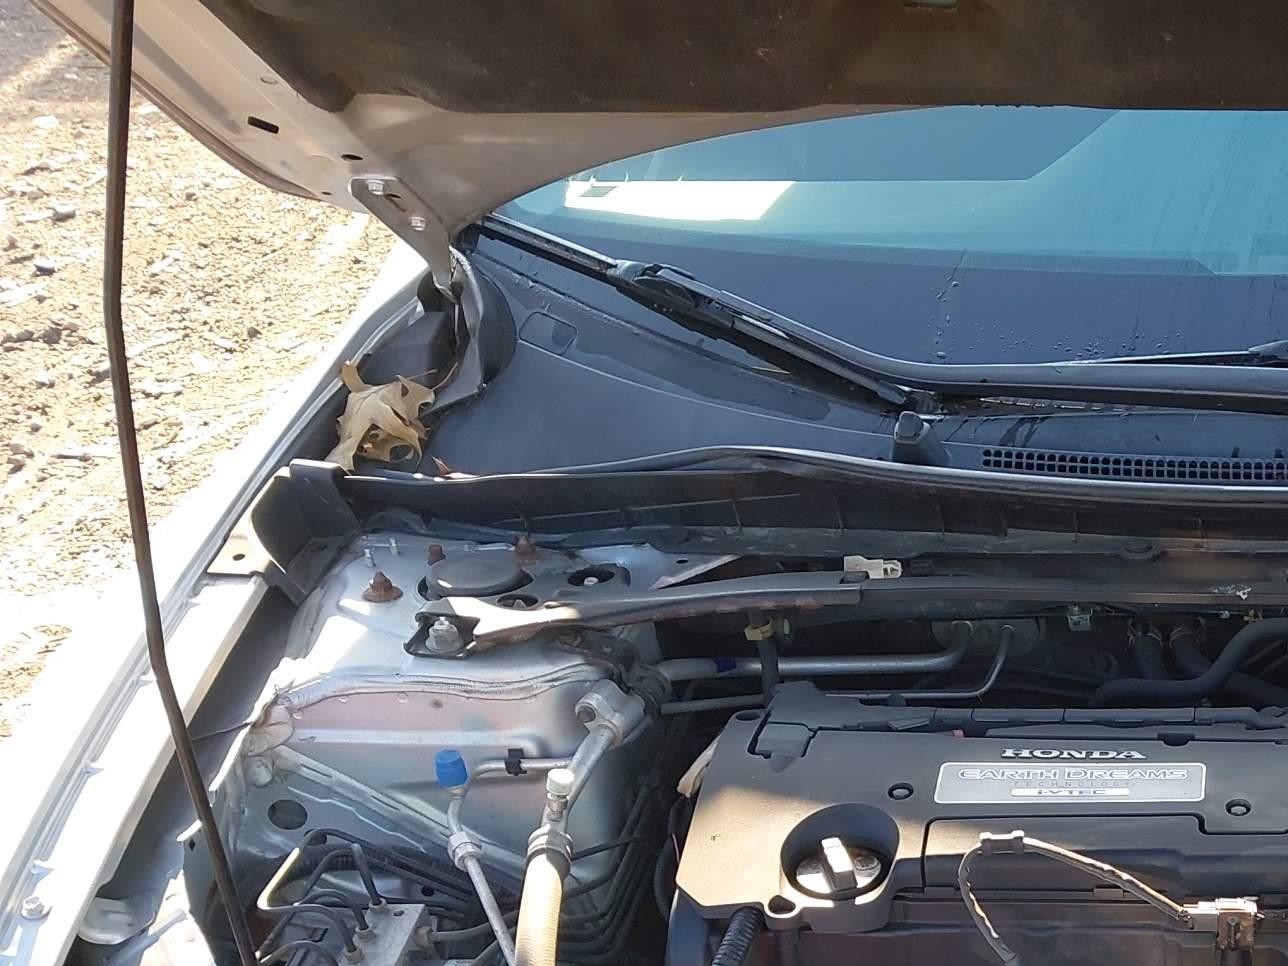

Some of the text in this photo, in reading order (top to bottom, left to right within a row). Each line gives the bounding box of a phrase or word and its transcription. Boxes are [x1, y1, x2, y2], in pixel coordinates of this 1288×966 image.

[1001, 748, 1147, 760] HONDA
[959, 767, 1188, 781] EARTH DREAMS
